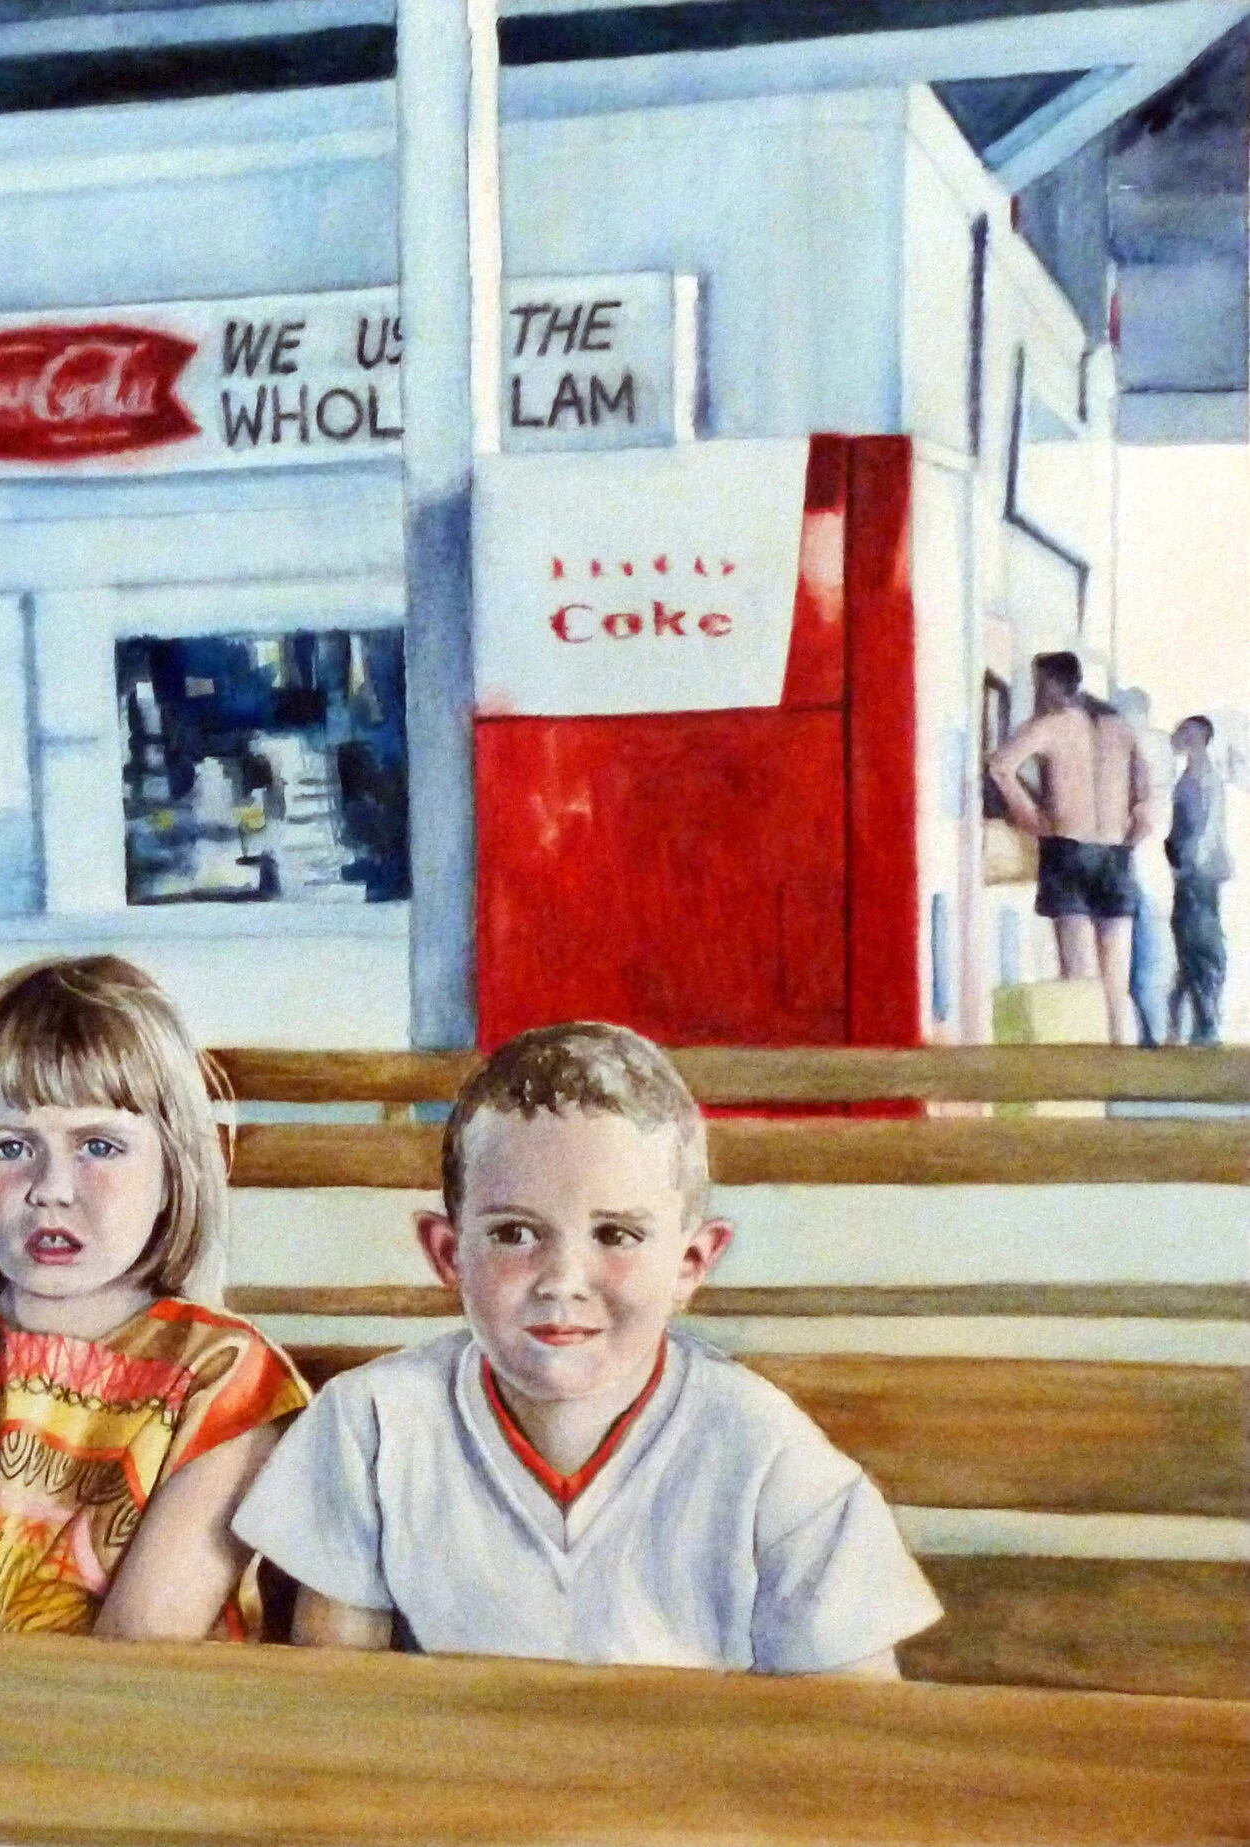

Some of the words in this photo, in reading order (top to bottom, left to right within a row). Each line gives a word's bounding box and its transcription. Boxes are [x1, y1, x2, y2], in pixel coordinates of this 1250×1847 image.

[223, 320, 306, 374] WE
[510, 300, 622, 356] THE
[221, 384, 405, 447] WHOL
[511, 366, 637, 428] LAM
[550, 601, 733, 644] Coke
